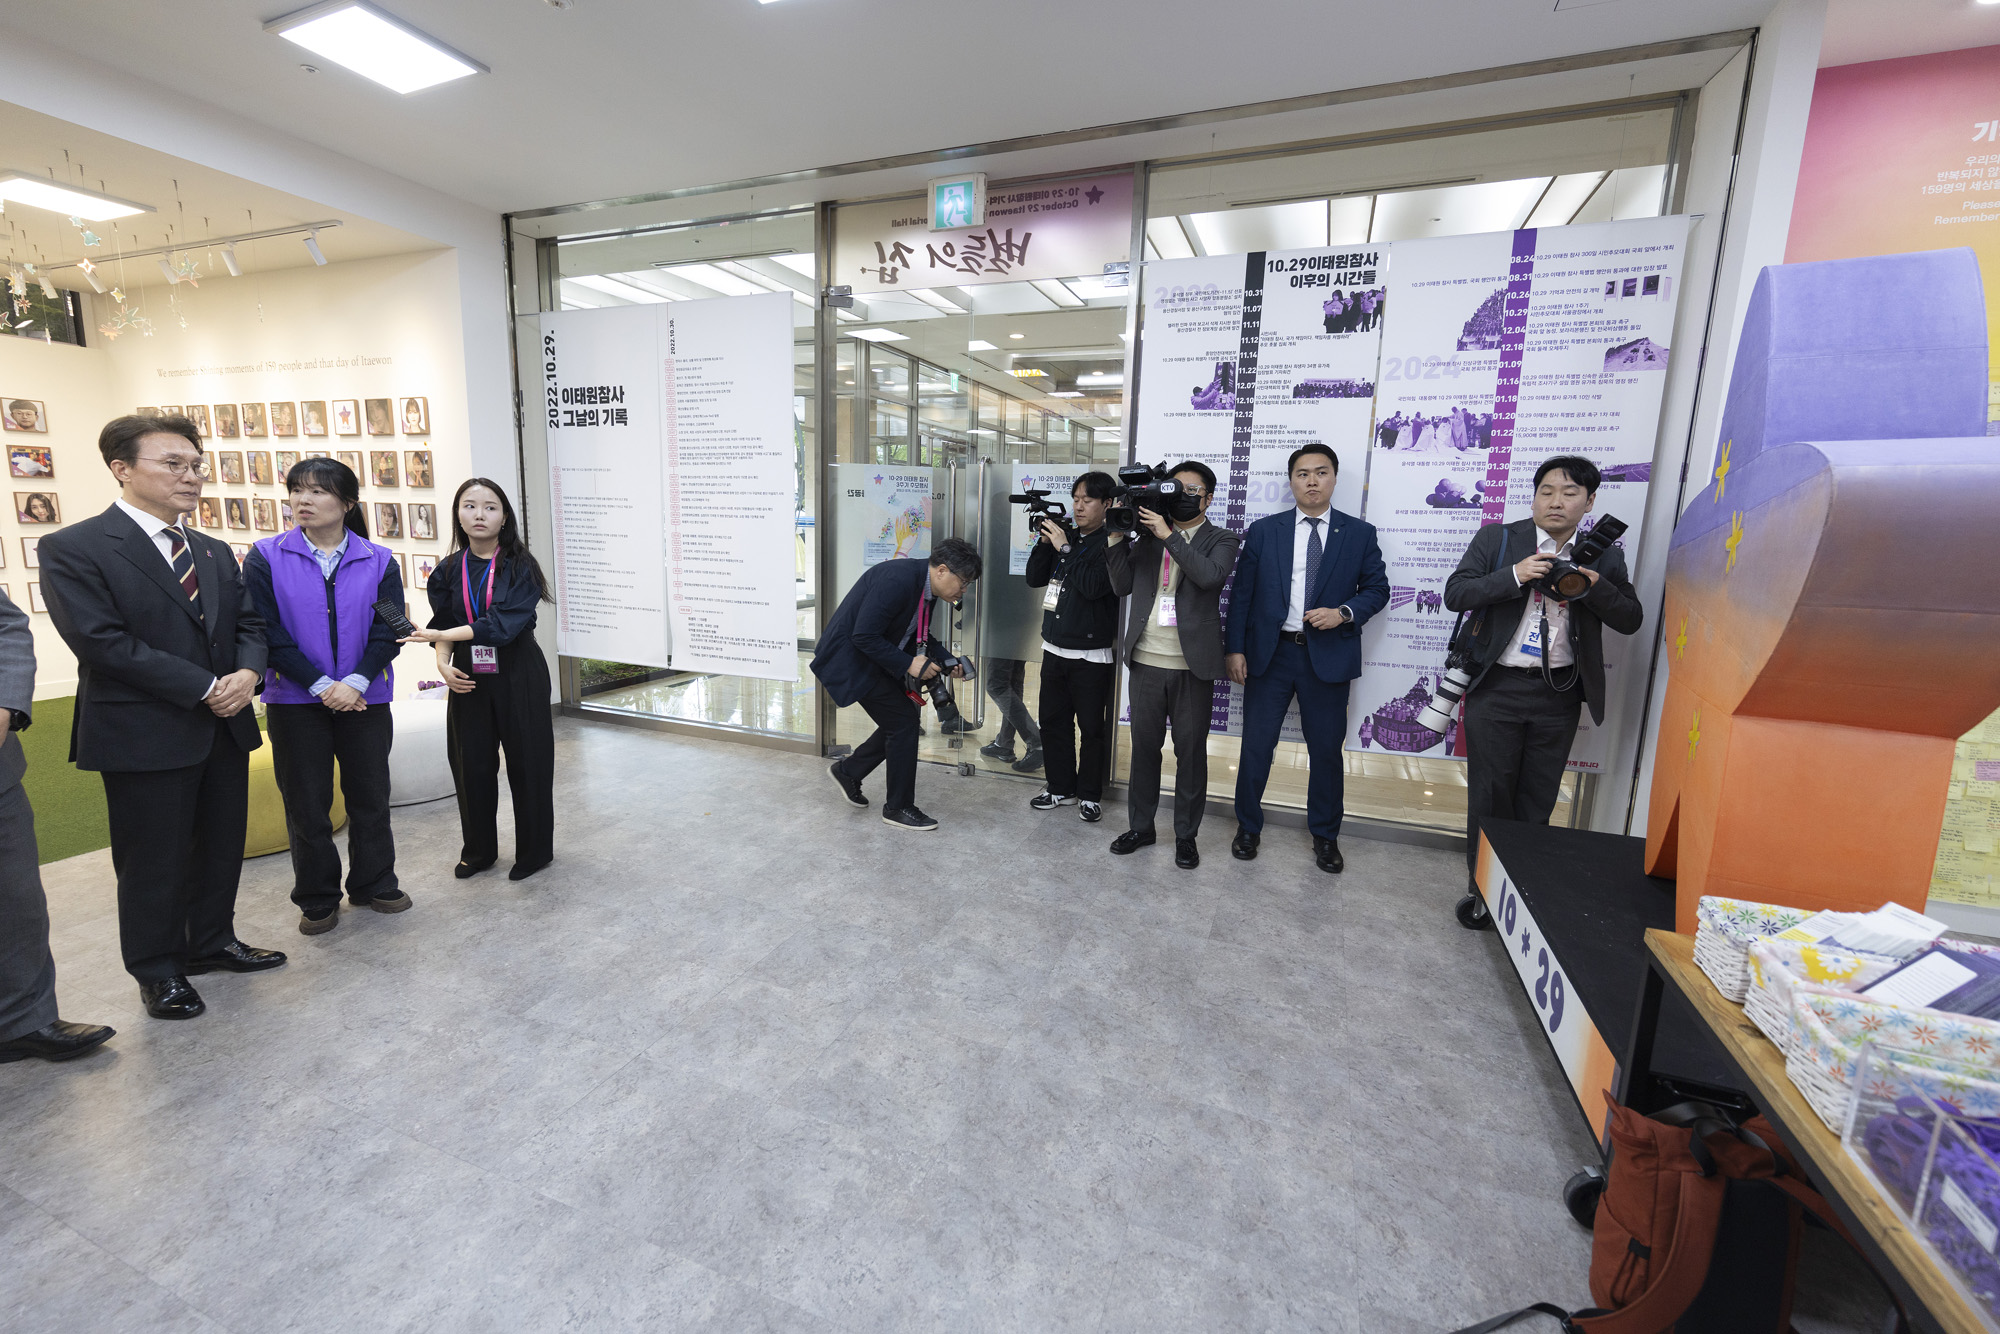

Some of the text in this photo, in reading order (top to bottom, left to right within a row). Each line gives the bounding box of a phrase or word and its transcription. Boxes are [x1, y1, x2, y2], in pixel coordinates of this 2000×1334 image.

[1971, 120, 2000, 142] 기
[1965, 154, 2000, 166] 우리의
[1937, 168, 1984, 182] 반복되지
[1921, 182, 1966, 194] 159명의
[1962, 200, 2000, 210] Please
[1934, 213, 2000, 225] Remember
[1268, 252, 1378, 273] 10.29이태원참사
[1511, 255, 1534, 264] 08.24
[1290, 270, 1376, 288] 이후의 시간들
[1509, 273, 1532, 281] 08.31
[1154, 283, 1218, 309] 2022
[1507, 291, 1530, 300] 10.26
[1505, 308, 1528, 317] 10.29
[157, 368, 166, 377] We
[168, 369, 198, 377] remember
[225, 365, 254, 374] moments
[257, 363, 263, 372] of
[265, 362, 276, 372] 159
[279, 360, 302, 373] people
[304, 360, 317, 369] and
[319, 359, 333, 368] that
[336, 358, 349, 369] day
[351, 356, 359, 366] of
[361, 355, 392, 366] Itaewon
[1384, 354, 1461, 382] 2024
[544, 330, 559, 428] 2022.10.29.
[1497, 378, 1520, 386] 01.16
[562, 385, 624, 405] 이태원참사
[563, 408, 628, 427] 그날의 기록
[1248, 481, 1296, 504] 202
[475, 649, 493, 658] 취재
[1498, 878, 1516, 936] 10
[1535, 947, 1564, 1034] 29
